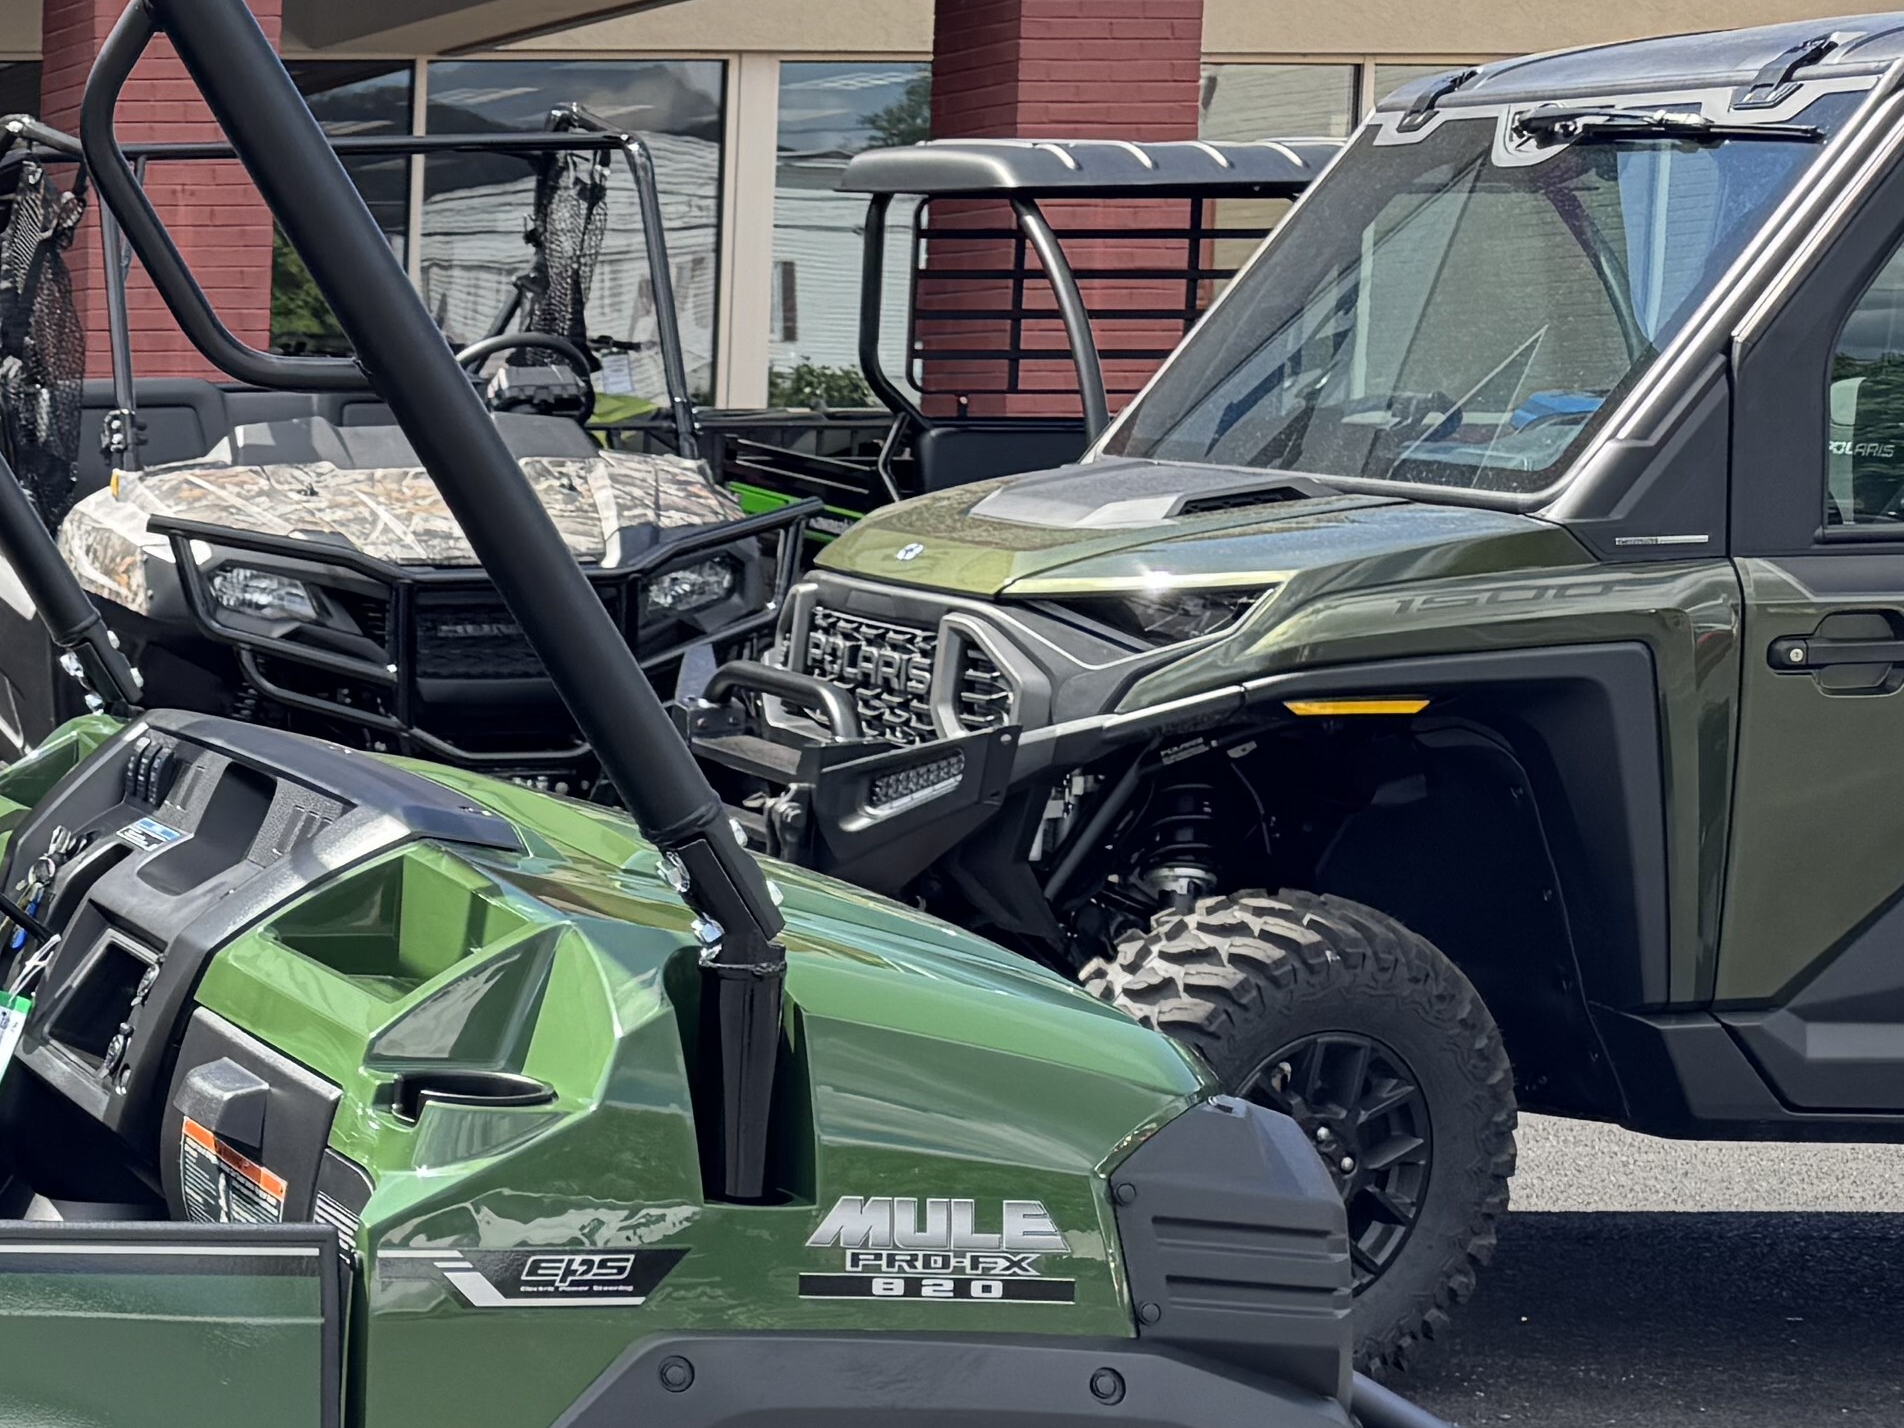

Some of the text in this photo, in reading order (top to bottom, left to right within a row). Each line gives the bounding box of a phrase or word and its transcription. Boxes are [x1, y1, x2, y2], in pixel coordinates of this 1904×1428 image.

[807, 631, 931, 695] POLARIS
[805, 1195, 1071, 1253] MULE
[521, 1254, 635, 1286] EPS
[845, 1249, 1041, 1276] PRO-FX
[872, 1278, 1003, 1299] 820
